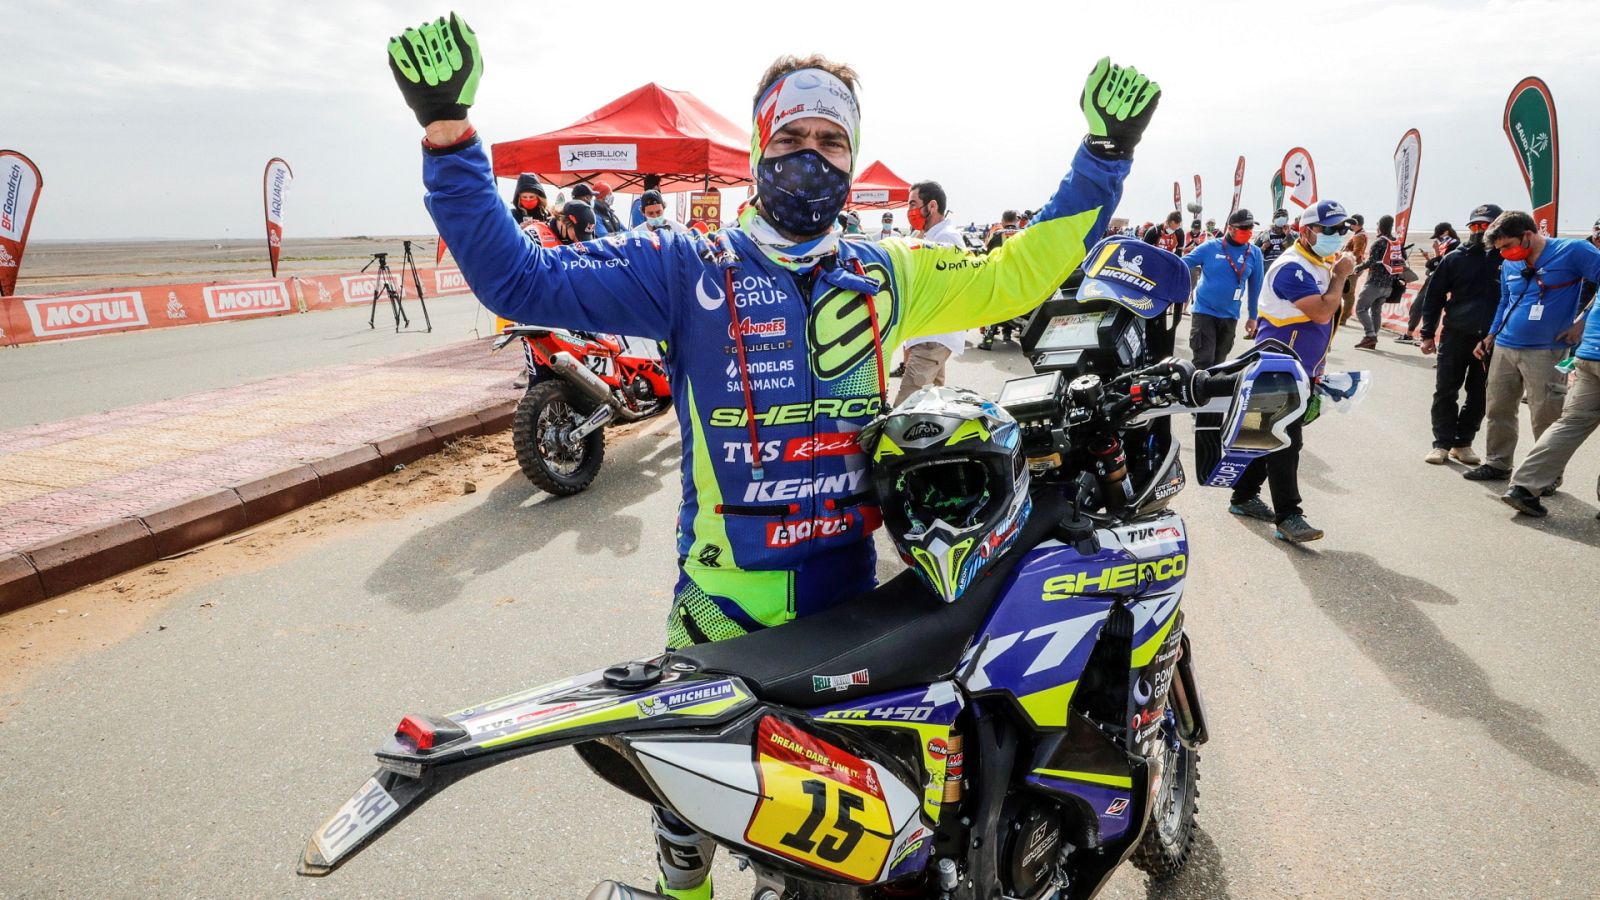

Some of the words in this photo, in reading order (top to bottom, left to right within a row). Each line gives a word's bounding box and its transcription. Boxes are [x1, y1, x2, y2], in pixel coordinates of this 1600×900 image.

[1515, 122, 1529, 150] SAUDI
[1, 164, 20, 231] BFGoodrich
[271, 168, 286, 217] AQUAFINA
[1099, 268, 1154, 292] MICHELIN
[219, 289, 281, 309] MOTUL
[734, 290, 788, 308] GRUP
[46, 300, 134, 327] MOTUL
[731, 342, 785, 354] GIJUELO
[591, 355, 608, 376] 21
[743, 470, 866, 502] KENNY
[669, 684, 731, 705] MICHELIN
[871, 706, 934, 720] 450
[771, 733, 804, 756] DREAM.
[806, 750, 831, 766] DARE.
[832, 761, 850, 774] LIVE
[779, 779, 865, 864] 15
